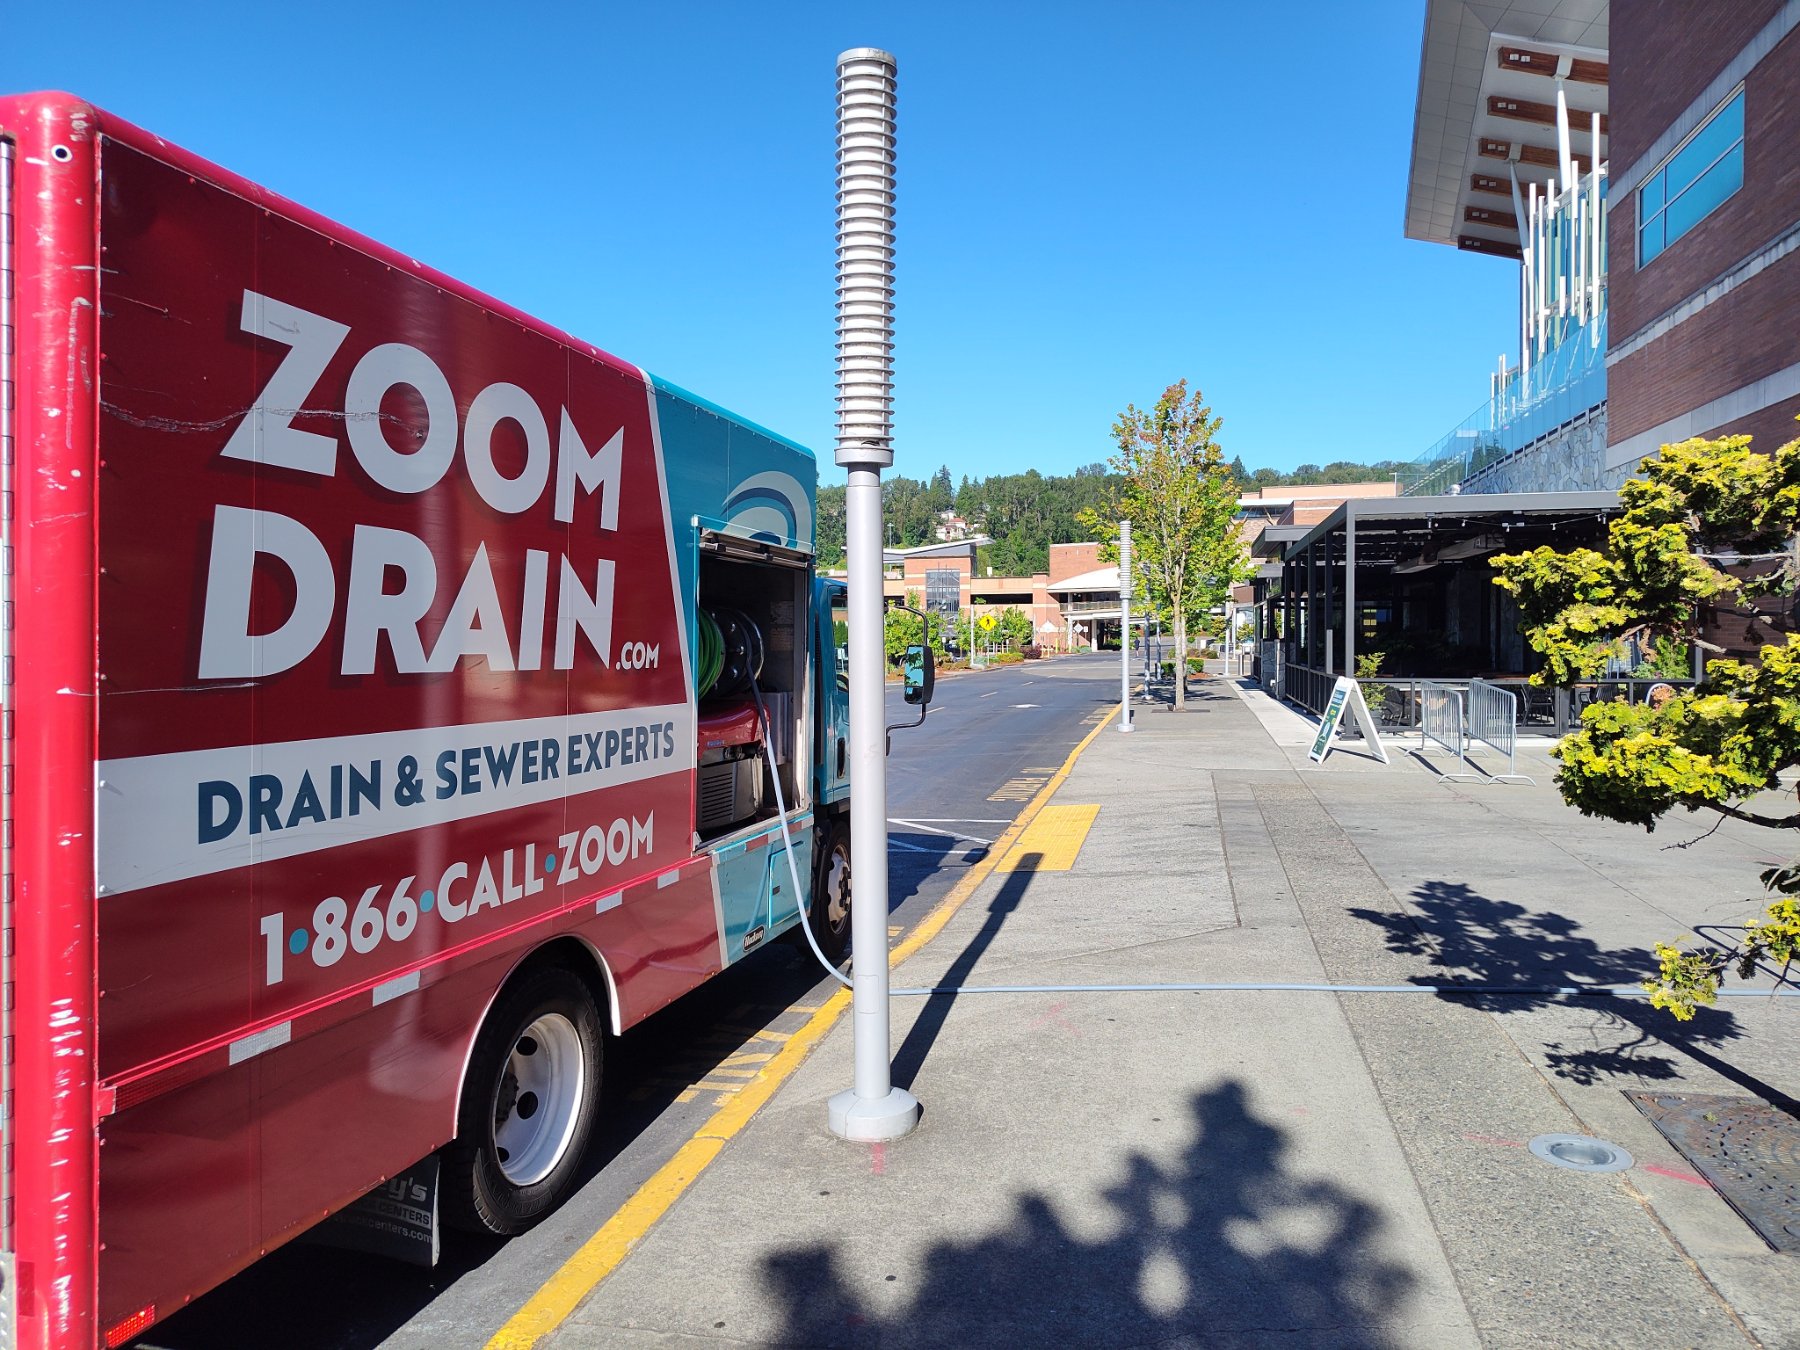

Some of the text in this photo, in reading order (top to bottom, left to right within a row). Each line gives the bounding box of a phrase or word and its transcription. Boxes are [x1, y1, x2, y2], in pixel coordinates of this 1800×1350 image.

[220, 287, 625, 532] ZOOM
[197, 503, 615, 680] DRAIN
[197, 720, 675, 845] DRAIN & SEWER EXPERTS
